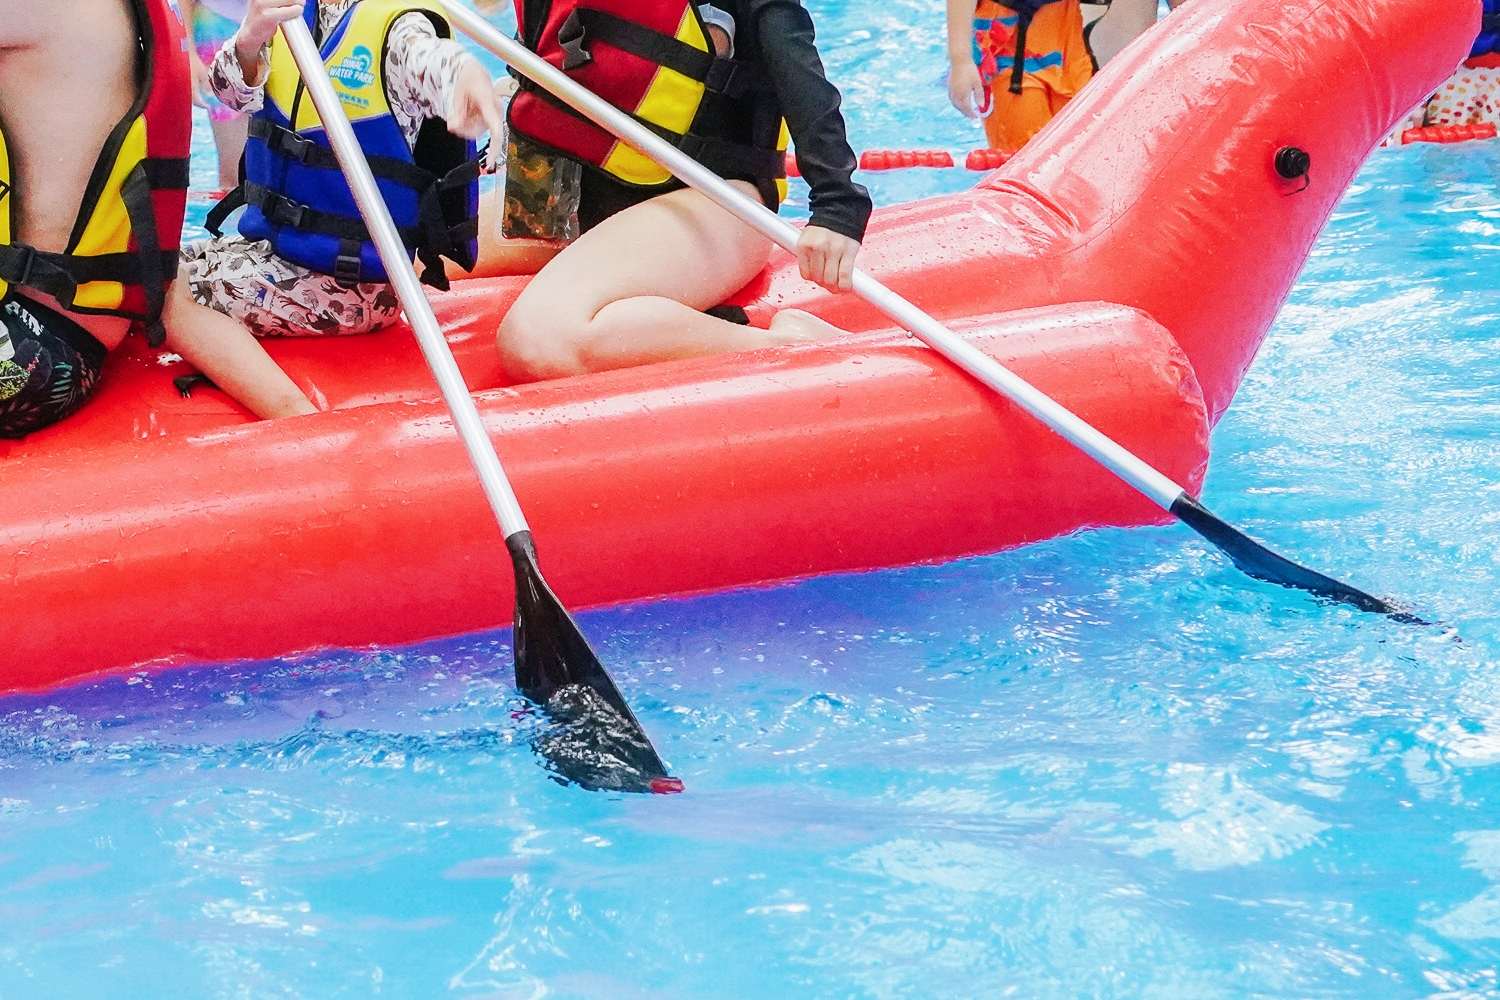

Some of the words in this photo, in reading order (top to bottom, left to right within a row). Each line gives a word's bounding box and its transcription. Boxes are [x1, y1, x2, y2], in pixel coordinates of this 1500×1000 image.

[342, 57, 365, 70] SUNAC
[329, 66, 353, 79] WATER
[353, 70, 375, 85] PARK
